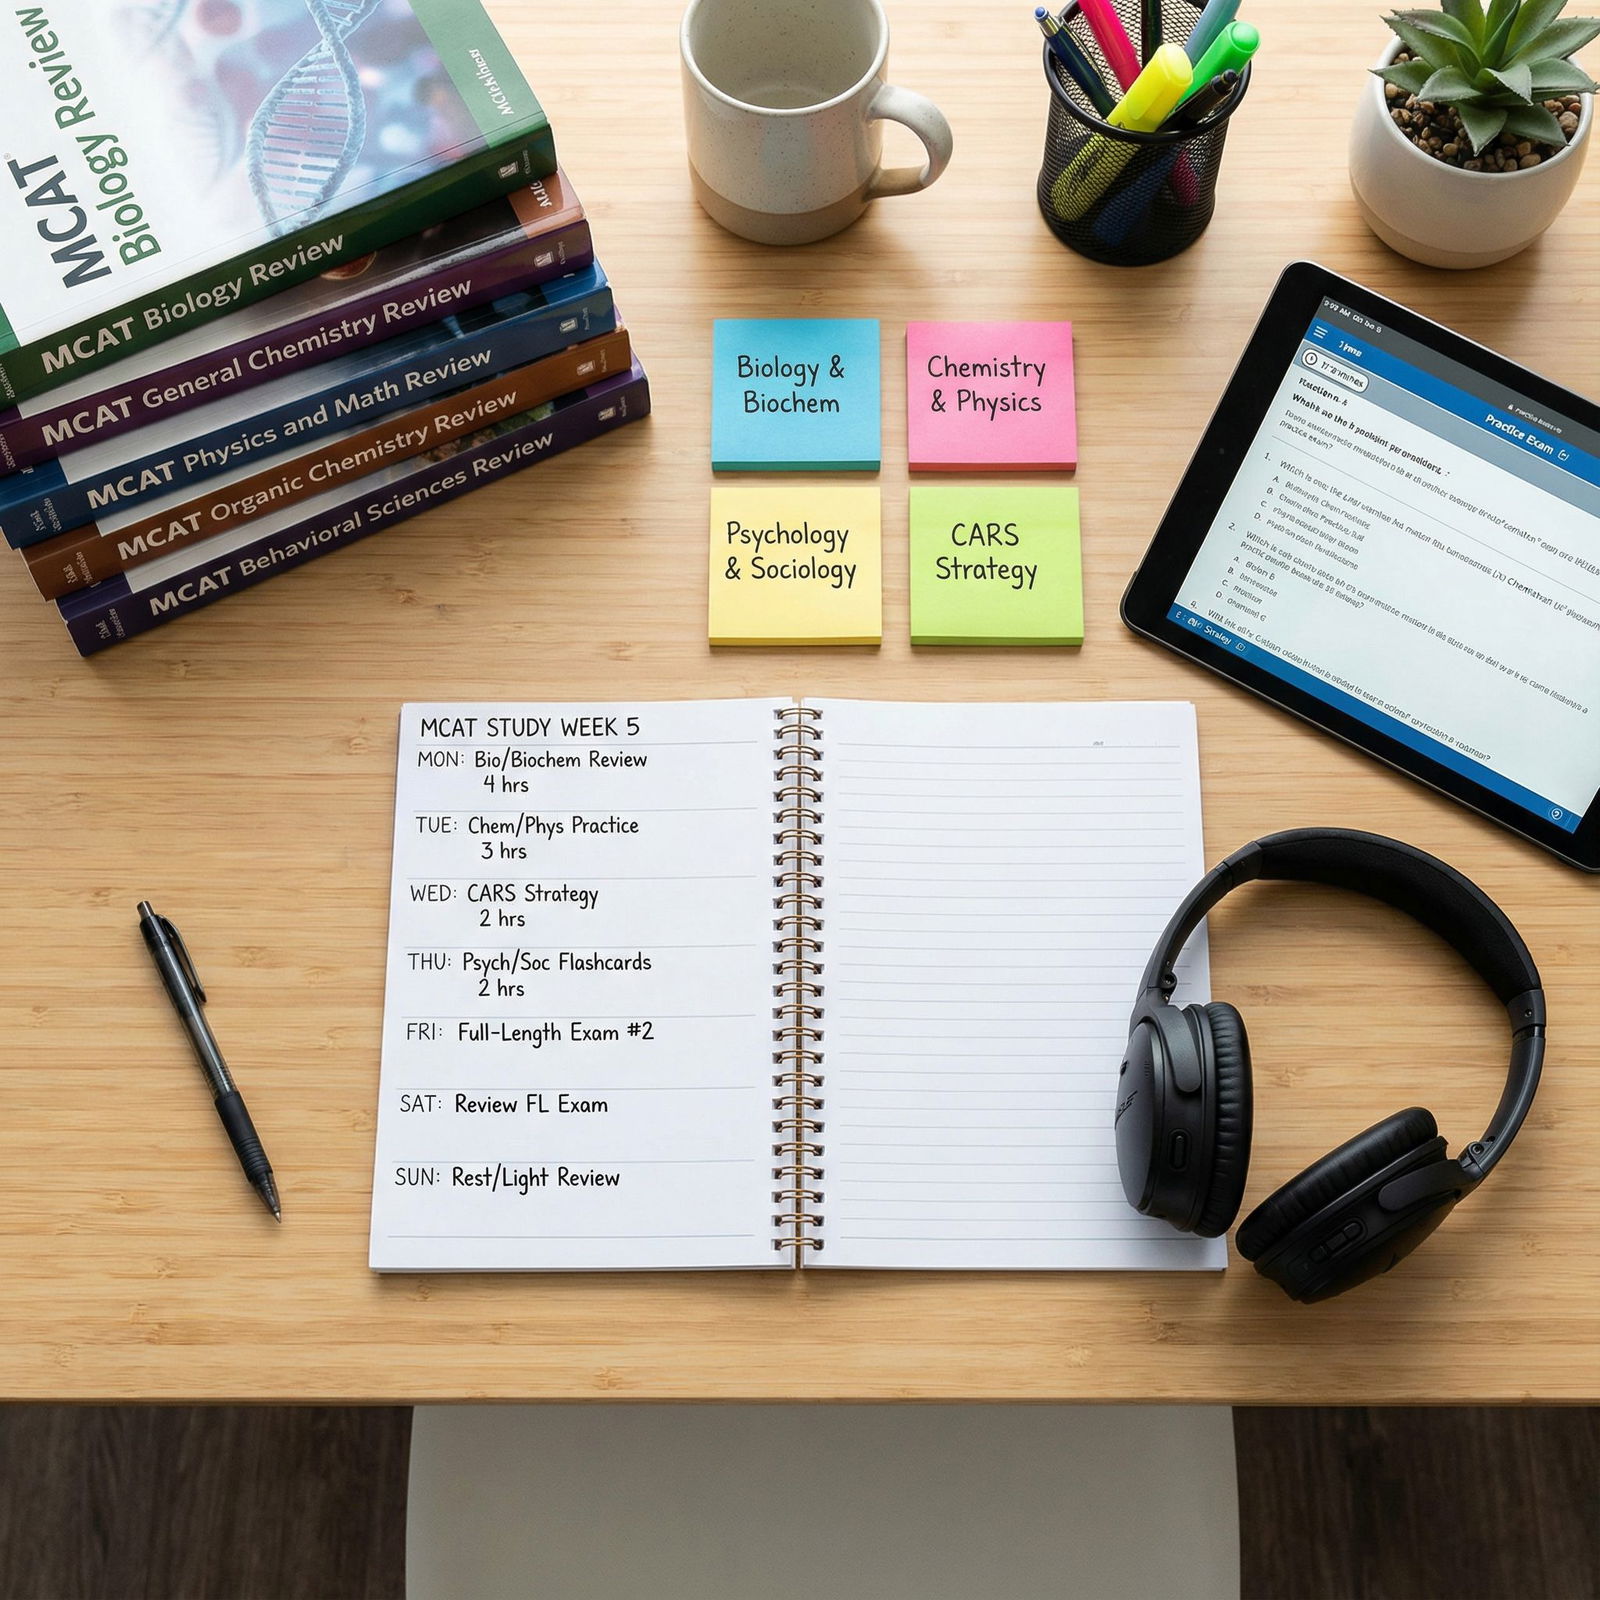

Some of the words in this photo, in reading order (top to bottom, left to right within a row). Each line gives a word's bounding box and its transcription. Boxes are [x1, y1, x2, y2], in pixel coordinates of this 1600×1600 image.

[15, 7, 96, 130] Review
[75, 134, 162, 266] Biology
[41, 316, 134, 374] MCAT
[143, 277, 242, 330] Biology
[248, 234, 343, 286] Review
[41, 396, 132, 446] MCAT
[142, 357, 242, 408] General
[248, 314, 376, 370] Chemistry
[382, 280, 471, 323] Review
[737, 354, 820, 388] Biology
[829, 354, 845, 379] &
[927, 354, 1046, 387] Chemistry
[744, 390, 840, 414] Biochem
[931, 388, 946, 413] &
[957, 388, 1042, 422] Physics
[86, 460, 175, 509] MCAT
[183, 429, 277, 473] Physics
[283, 404, 328, 436] and
[334, 380, 400, 417] Math
[404, 350, 491, 391] Review
[117, 511, 201, 560] MCAT
[211, 477, 304, 521] Organic
[308, 426, 428, 482] Chemistry
[434, 391, 517, 433] Review
[149, 566, 231, 615] MCAT
[239, 511, 361, 576] Behavioral
[367, 471, 467, 521] Sciences
[472, 433, 553, 476] Review
[727, 520, 849, 554] Psychology
[951, 522, 1019, 547] CARS
[725, 556, 741, 580] &
[751, 556, 857, 589] Sociology
[936, 556, 1038, 590] Strategy
[421, 717, 478, 738] MCAT
[487, 717, 552, 738] STUDY
[560, 716, 618, 737] WEEK
[627, 716, 640, 736] 5
[417, 750, 464, 768] MON:
[475, 746, 581, 772] Bio/Biochem
[589, 749, 648, 768] Review
[483, 774, 495, 794] 4
[502, 774, 529, 793] hrs
[415, 816, 457, 834] TUE:
[468, 812, 564, 841] Chem/Phys
[572, 815, 640, 834] Practice
[481, 841, 494, 860] 3
[500, 841, 527, 860] hrs
[410, 884, 457, 902] WED:
[467, 883, 516, 903] CARS
[524, 883, 599, 910] Strategy
[479, 908, 491, 927] 2
[498, 908, 526, 927] hrs
[407, 952, 451, 971] THU:
[463, 948, 551, 978] Psych/Soc
[559, 951, 652, 971] Flashcards
[478, 978, 491, 997] 2
[497, 978, 525, 997] hrs
[407, 1022, 443, 1041] FRI:
[458, 1021, 562, 1049] Full-Length
[570, 1021, 619, 1042] Exam
[626, 1021, 655, 1040] #2
[400, 1094, 442, 1113] SAT:
[455, 1093, 518, 1114] Review
[526, 1093, 550, 1114] FL
[558, 1093, 608, 1113] Exam
[394, 1167, 440, 1186] SUN:
[452, 1162, 550, 1196] Rest/Light
[558, 1166, 620, 1187] Review
